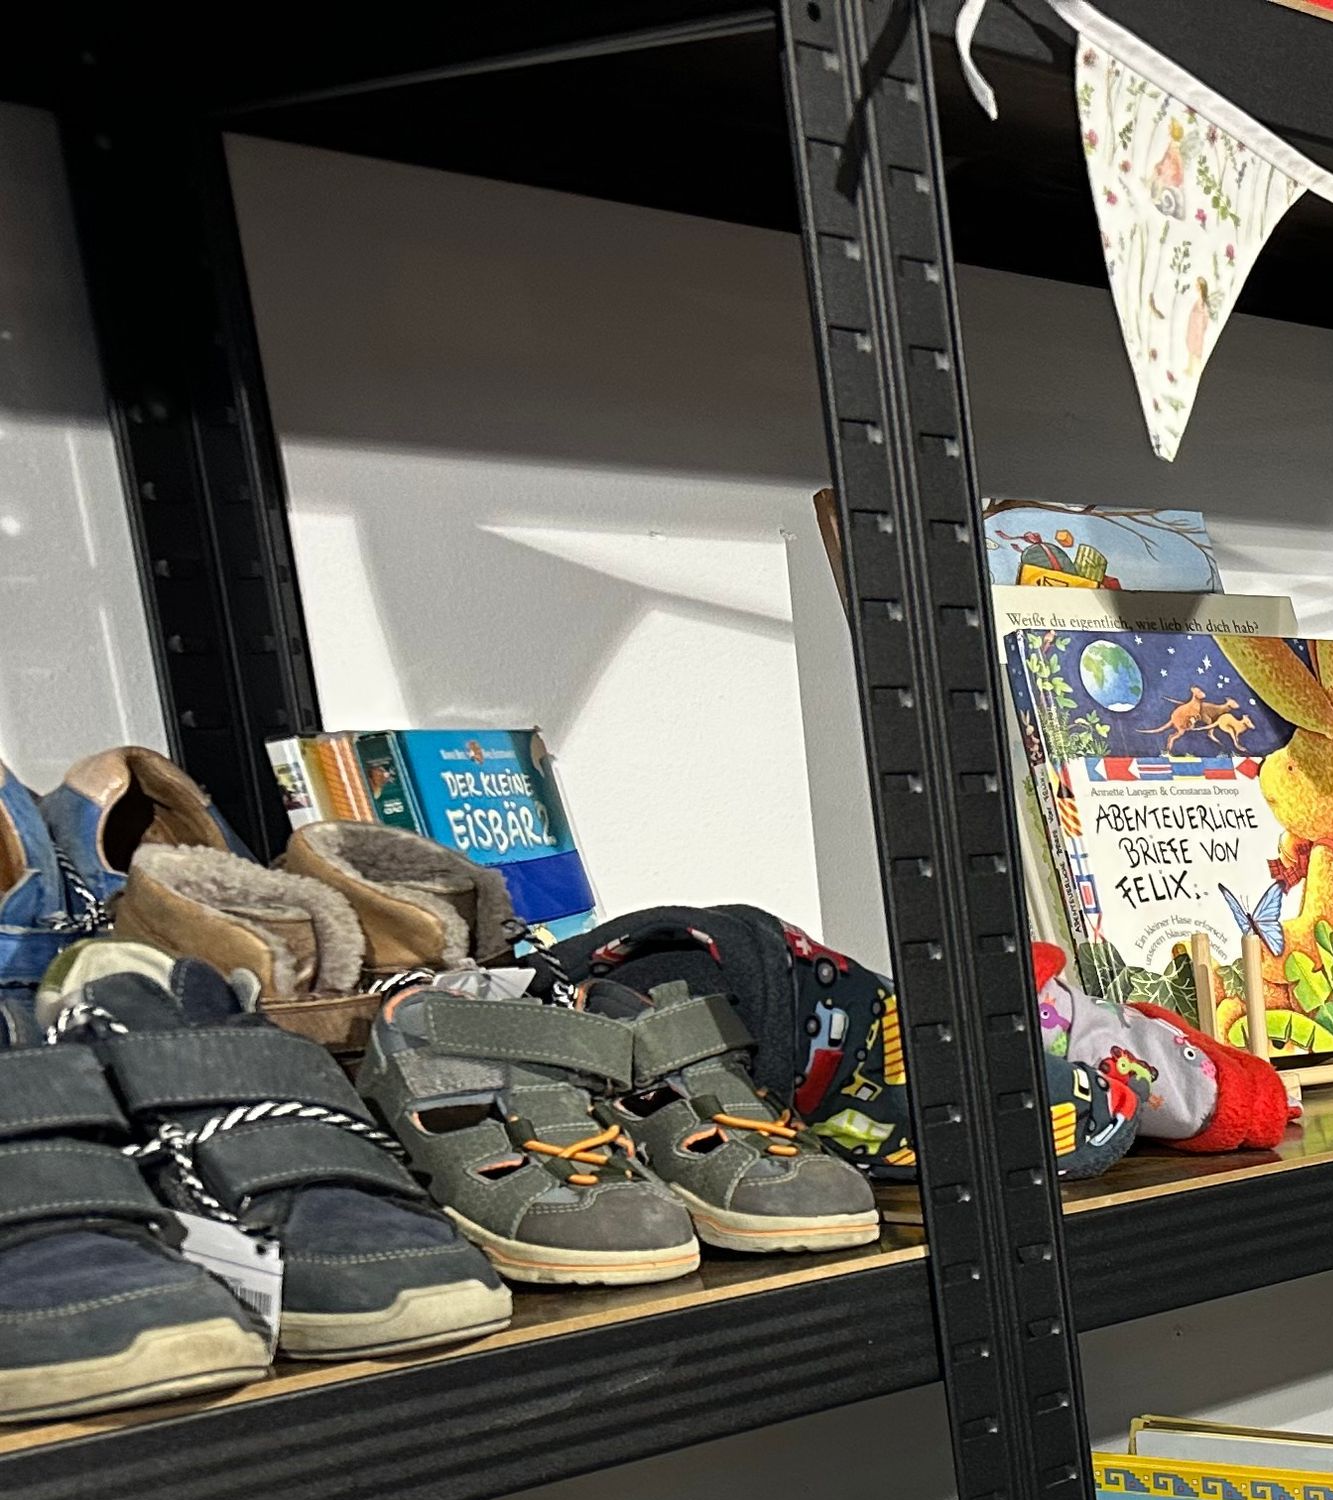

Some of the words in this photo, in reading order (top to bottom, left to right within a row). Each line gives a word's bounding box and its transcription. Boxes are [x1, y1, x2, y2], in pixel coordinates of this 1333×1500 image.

[1007, 612, 1046, 628] Weißt
[1050, 614, 1066, 629] du
[1070, 614, 1133, 632] eigentlich,
[1136, 618, 1157, 631] wie
[1160, 617, 1183, 632] lieb
[1185, 618, 1202, 632] ich
[1206, 619, 1231, 633] dich
[441, 769, 478, 799] DER
[1091, 786, 1124, 798] Annette
[1126, 786, 1159, 799] Langen
[1160, 787, 1168, 797] &
[1169, 786, 1212, 796] Constanza
[1213, 785, 1239, 797] Droop
[540, 815, 557, 847] 2
[1200, 838, 1239, 862] VON
[1135, 935, 1148, 950] Ein
[1145, 918, 1170, 940] kleiner
[1170, 914, 1192, 925] Hase
[1194, 919, 1228, 945] erforscht
